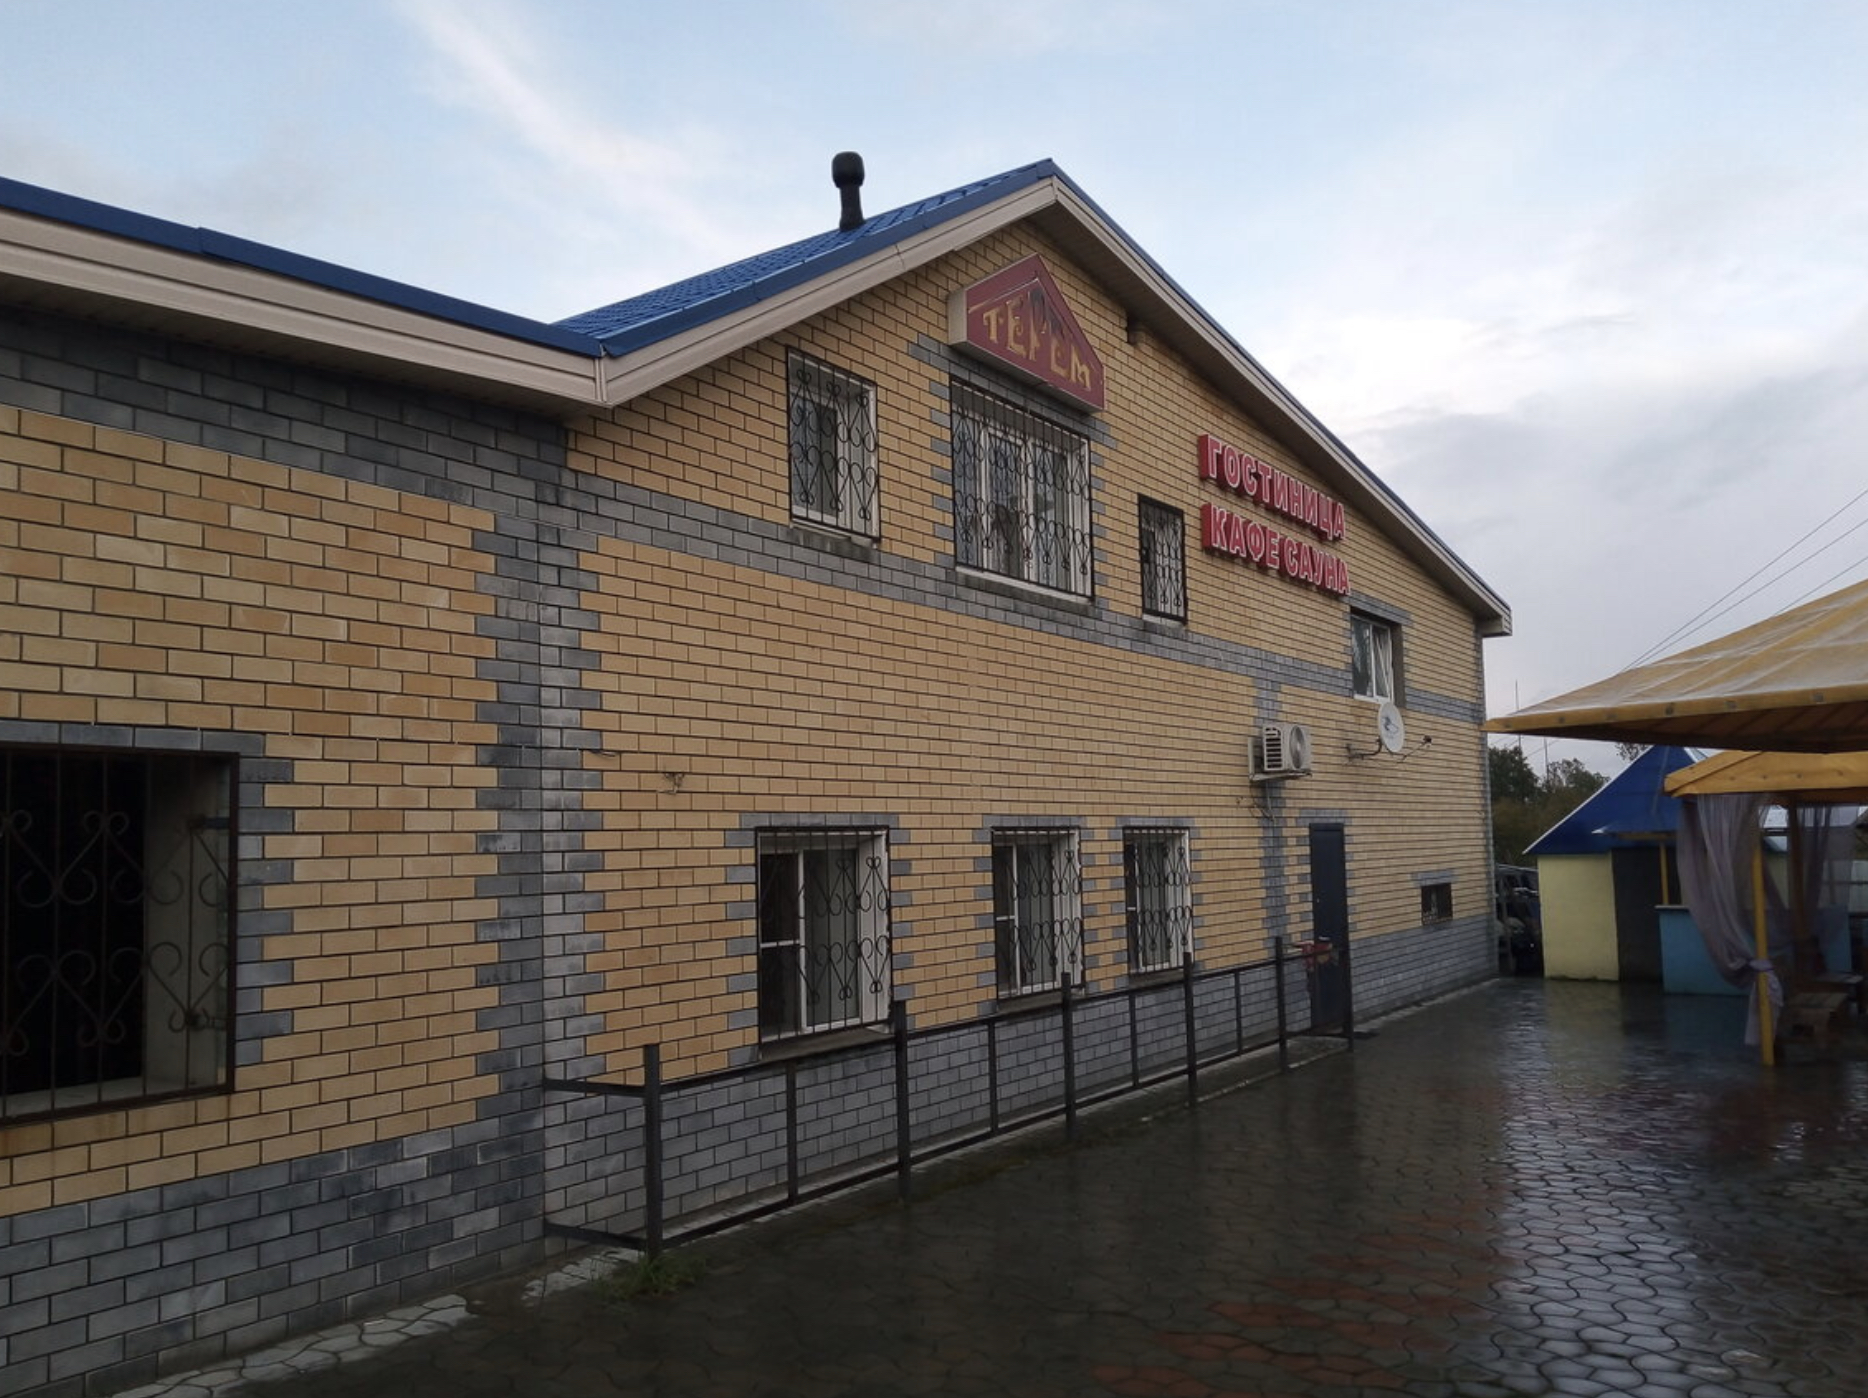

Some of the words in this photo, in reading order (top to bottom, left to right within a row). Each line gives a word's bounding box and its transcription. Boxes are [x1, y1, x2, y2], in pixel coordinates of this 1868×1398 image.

[1204, 434, 1346, 541] ГОСТИНИЦА
[1208, 503, 1281, 570] КАФЕ
[1283, 535, 1351, 595] САУНА
